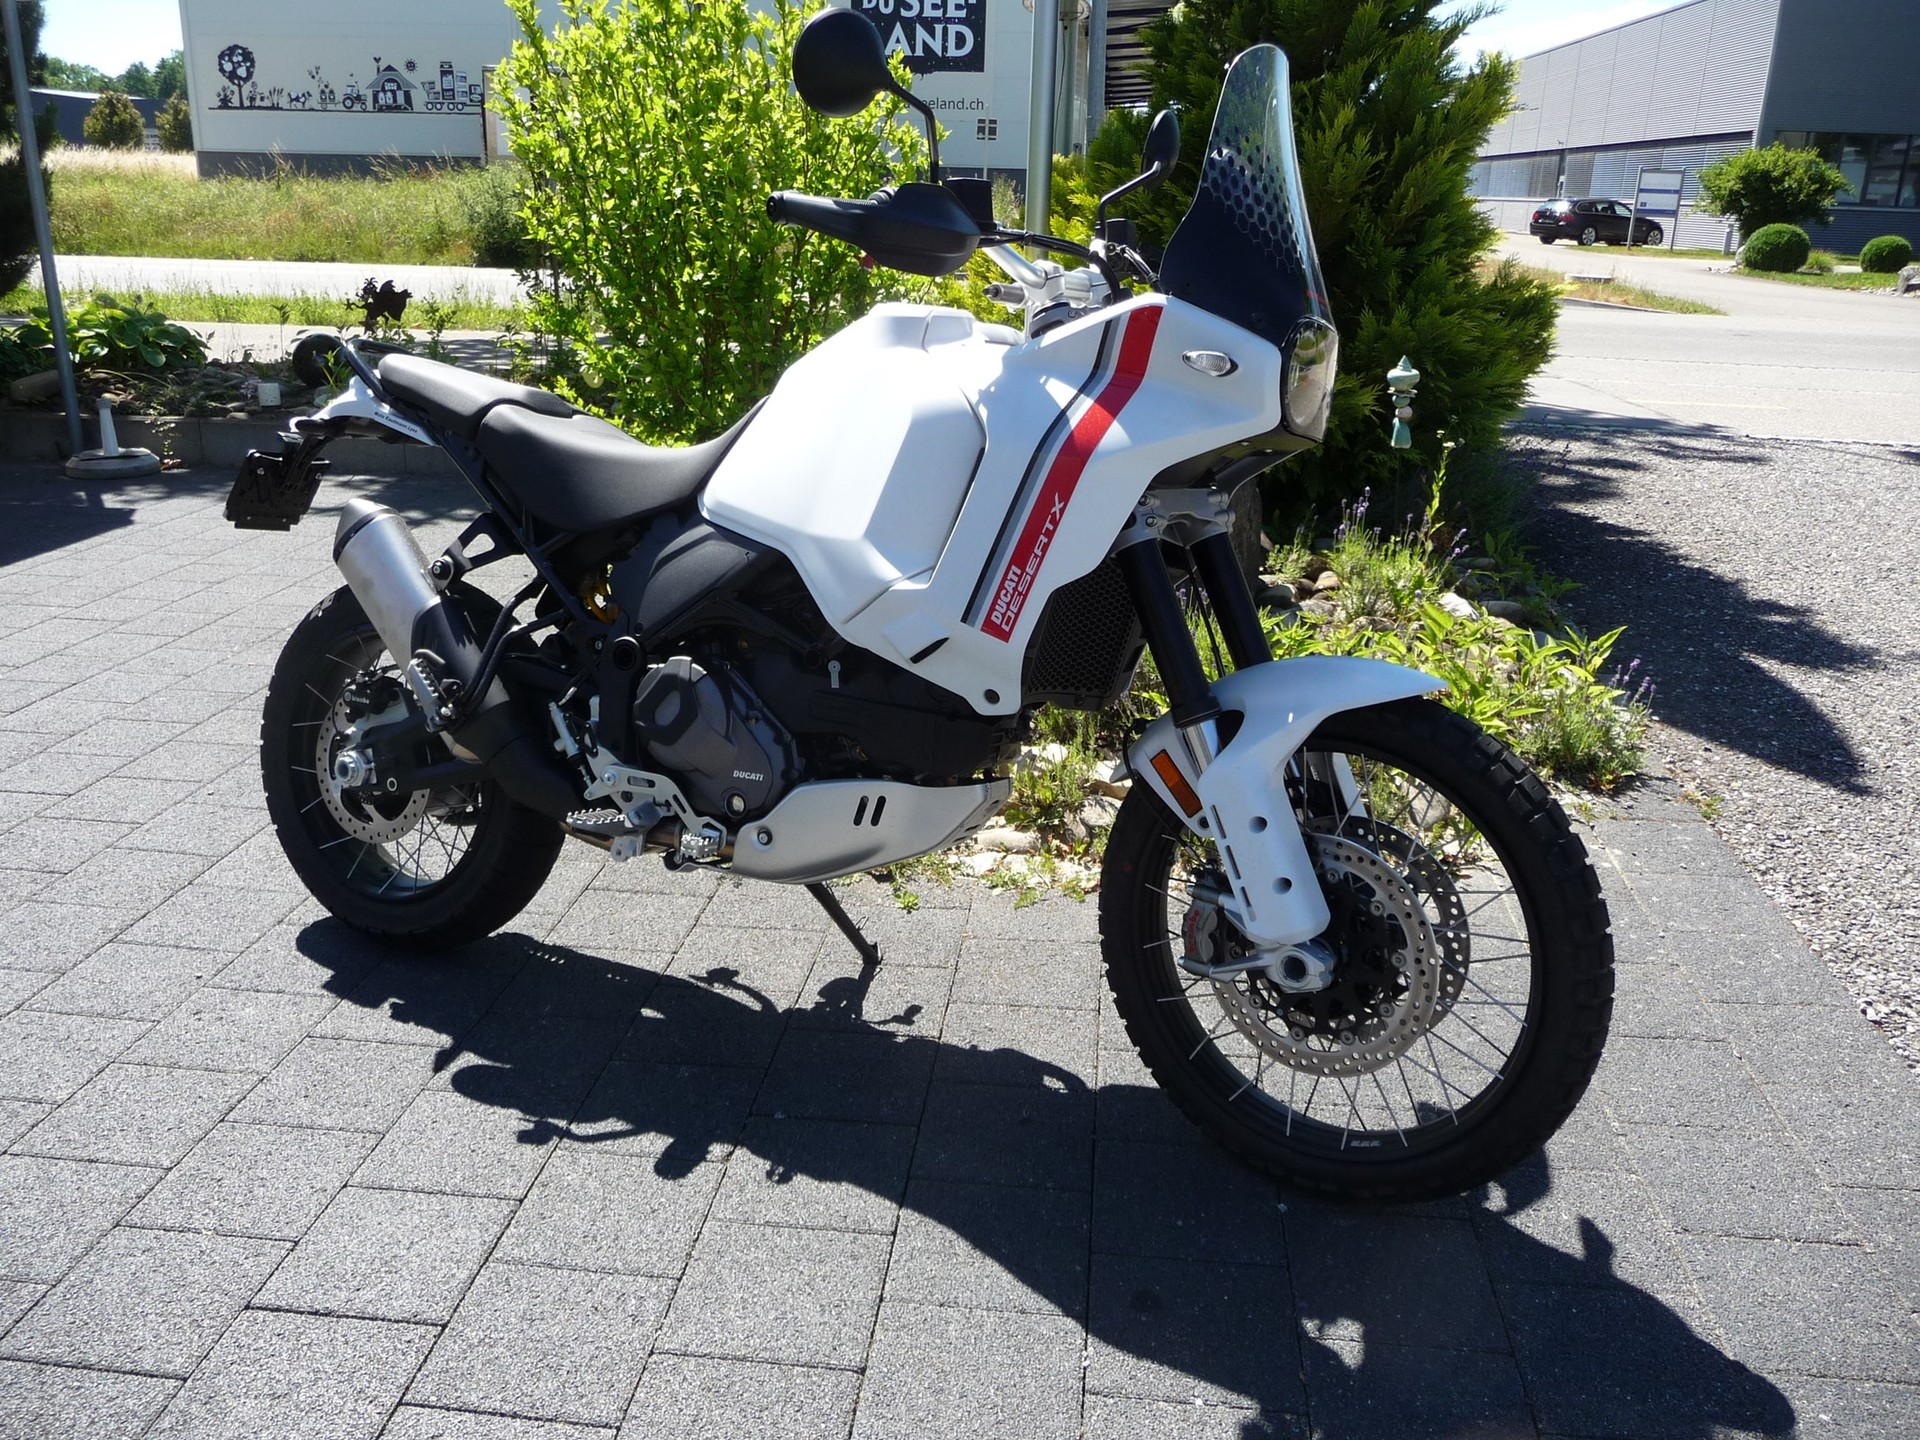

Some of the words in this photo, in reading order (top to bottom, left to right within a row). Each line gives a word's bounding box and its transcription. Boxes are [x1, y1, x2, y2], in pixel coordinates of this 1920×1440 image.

[884, 21, 974, 57] AND
[1001, 491, 1065, 633] DESERTX
[990, 564, 1022, 626] DUCATI
[732, 769, 764, 782] DUCATI
